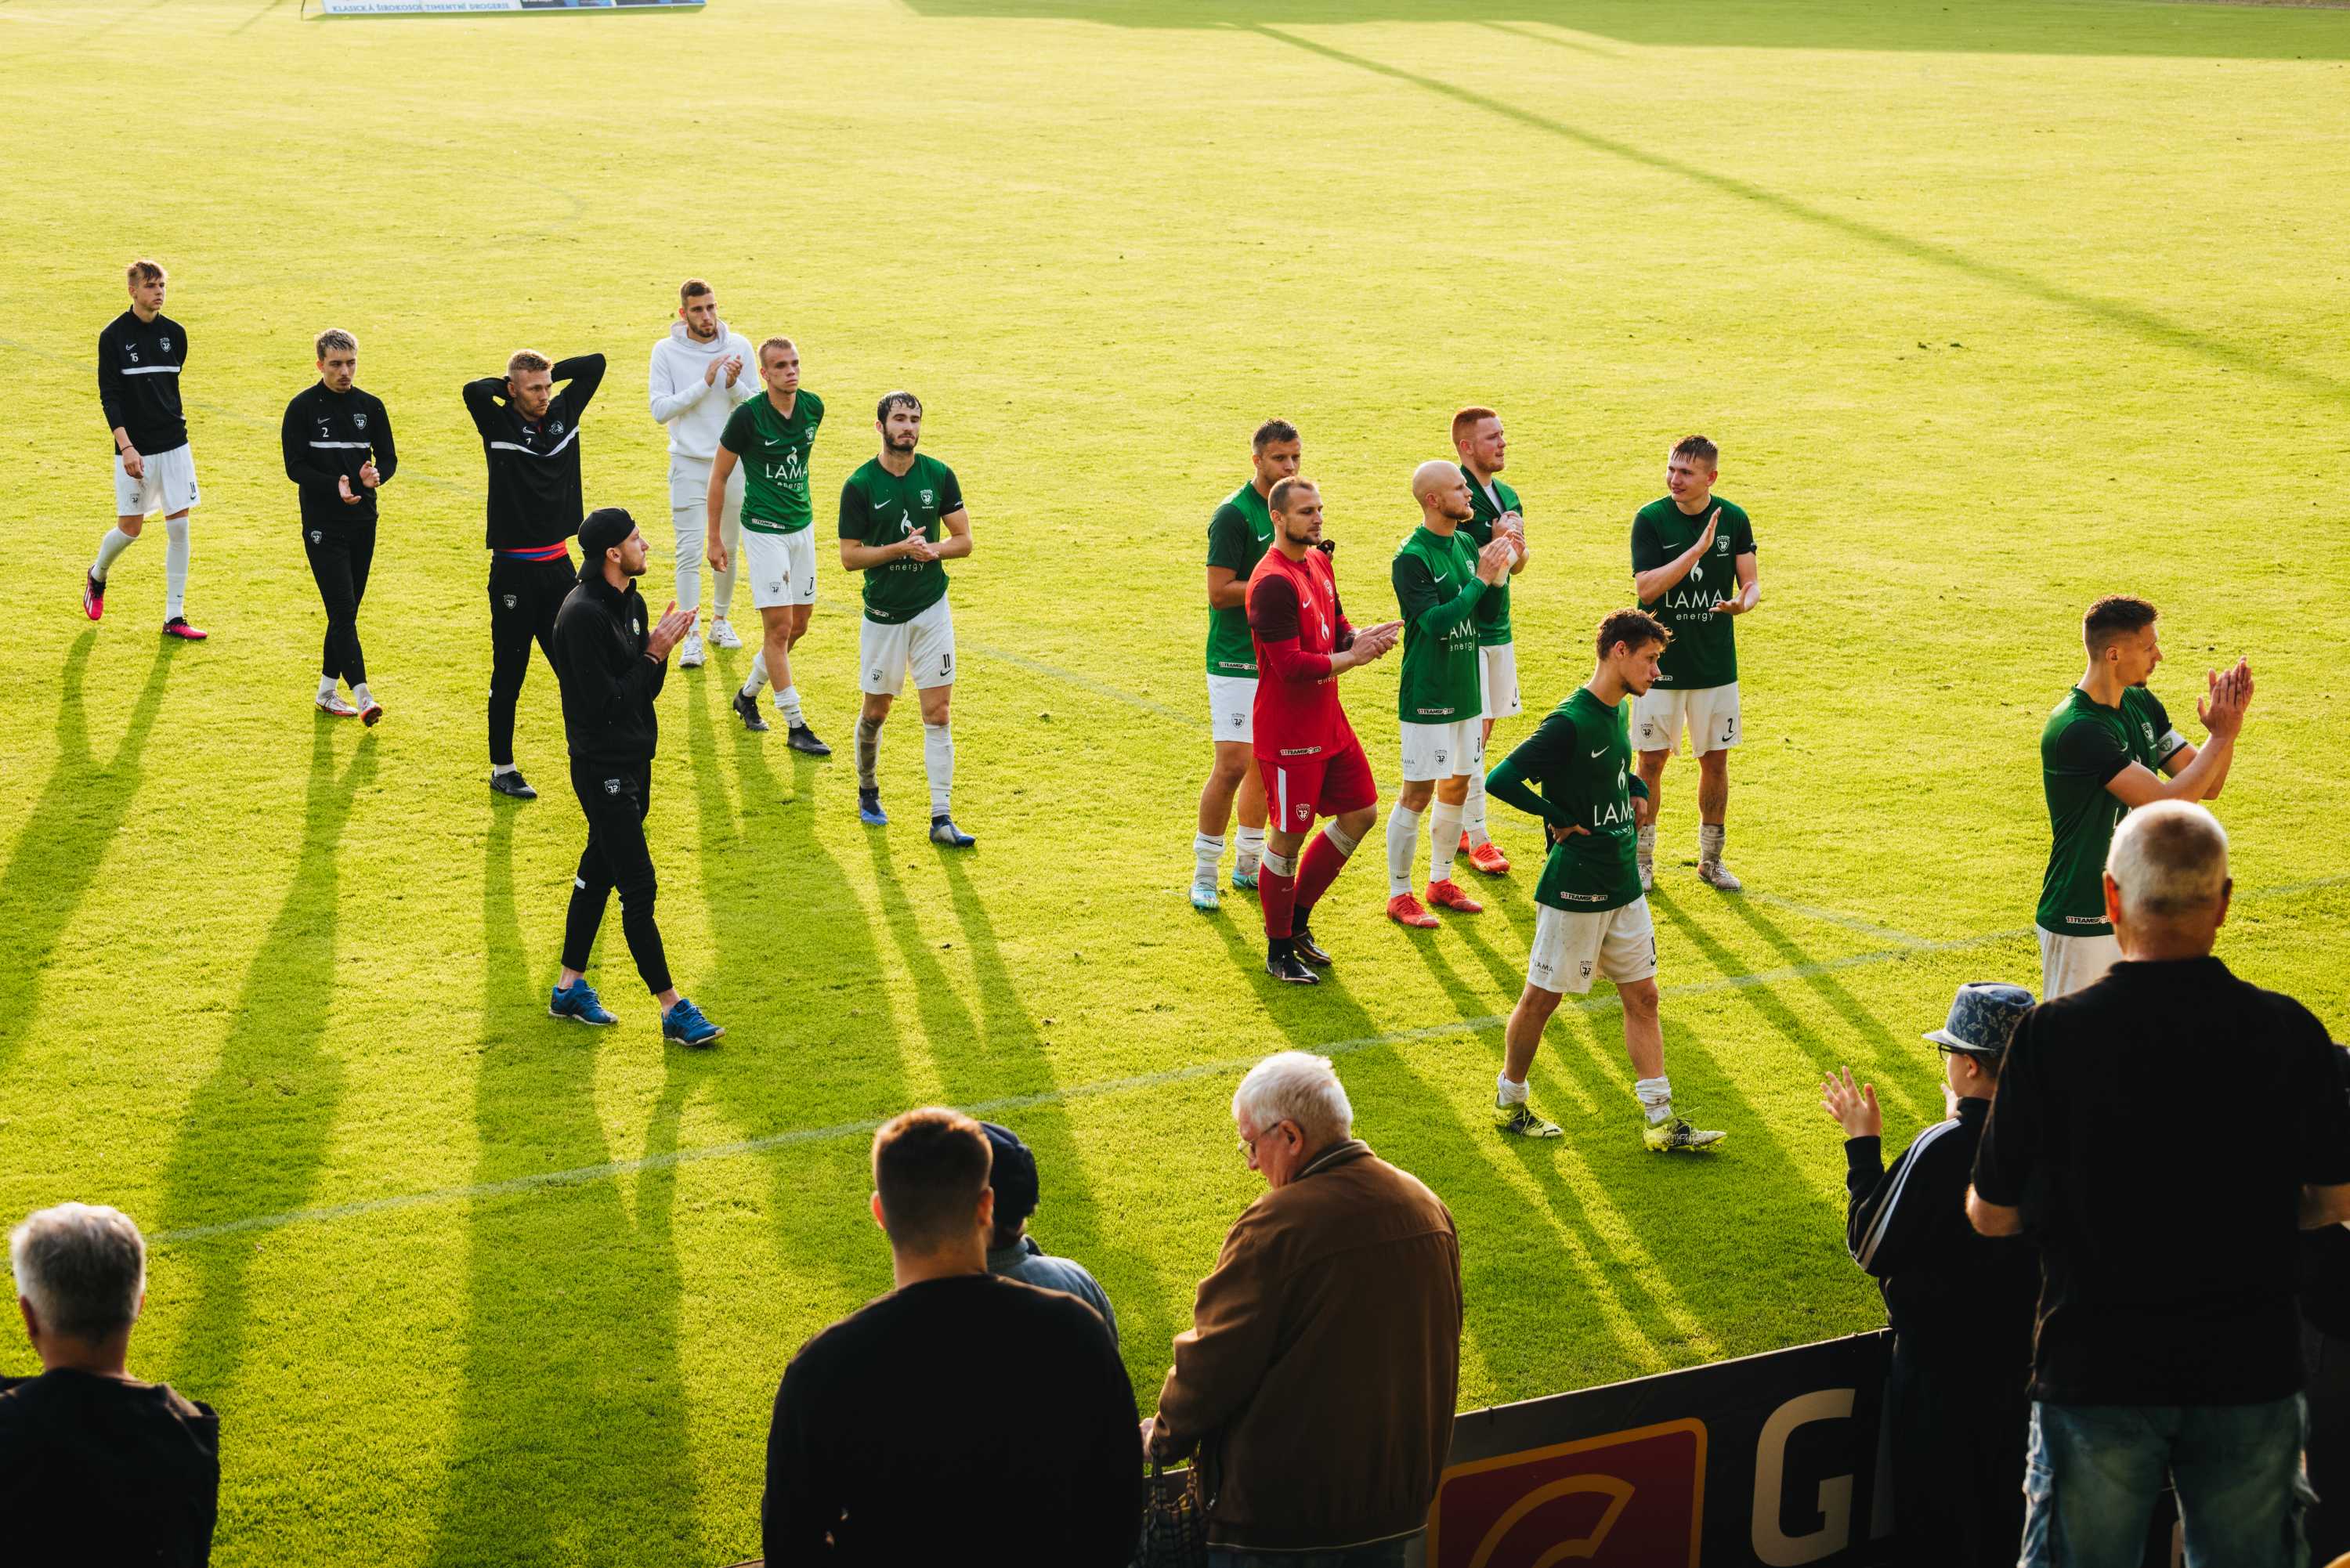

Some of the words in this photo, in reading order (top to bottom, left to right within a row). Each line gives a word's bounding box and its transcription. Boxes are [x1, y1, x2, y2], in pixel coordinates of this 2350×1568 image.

[321, 427, 329, 438] 2
[889, 562, 924, 572] energy
[810, 576, 815, 590] 7
[1665, 588, 1724, 609] LAMA
[1676, 612, 1714, 622] energy
[942, 653, 951, 669] 11
[1727, 717, 1734, 733] 2
